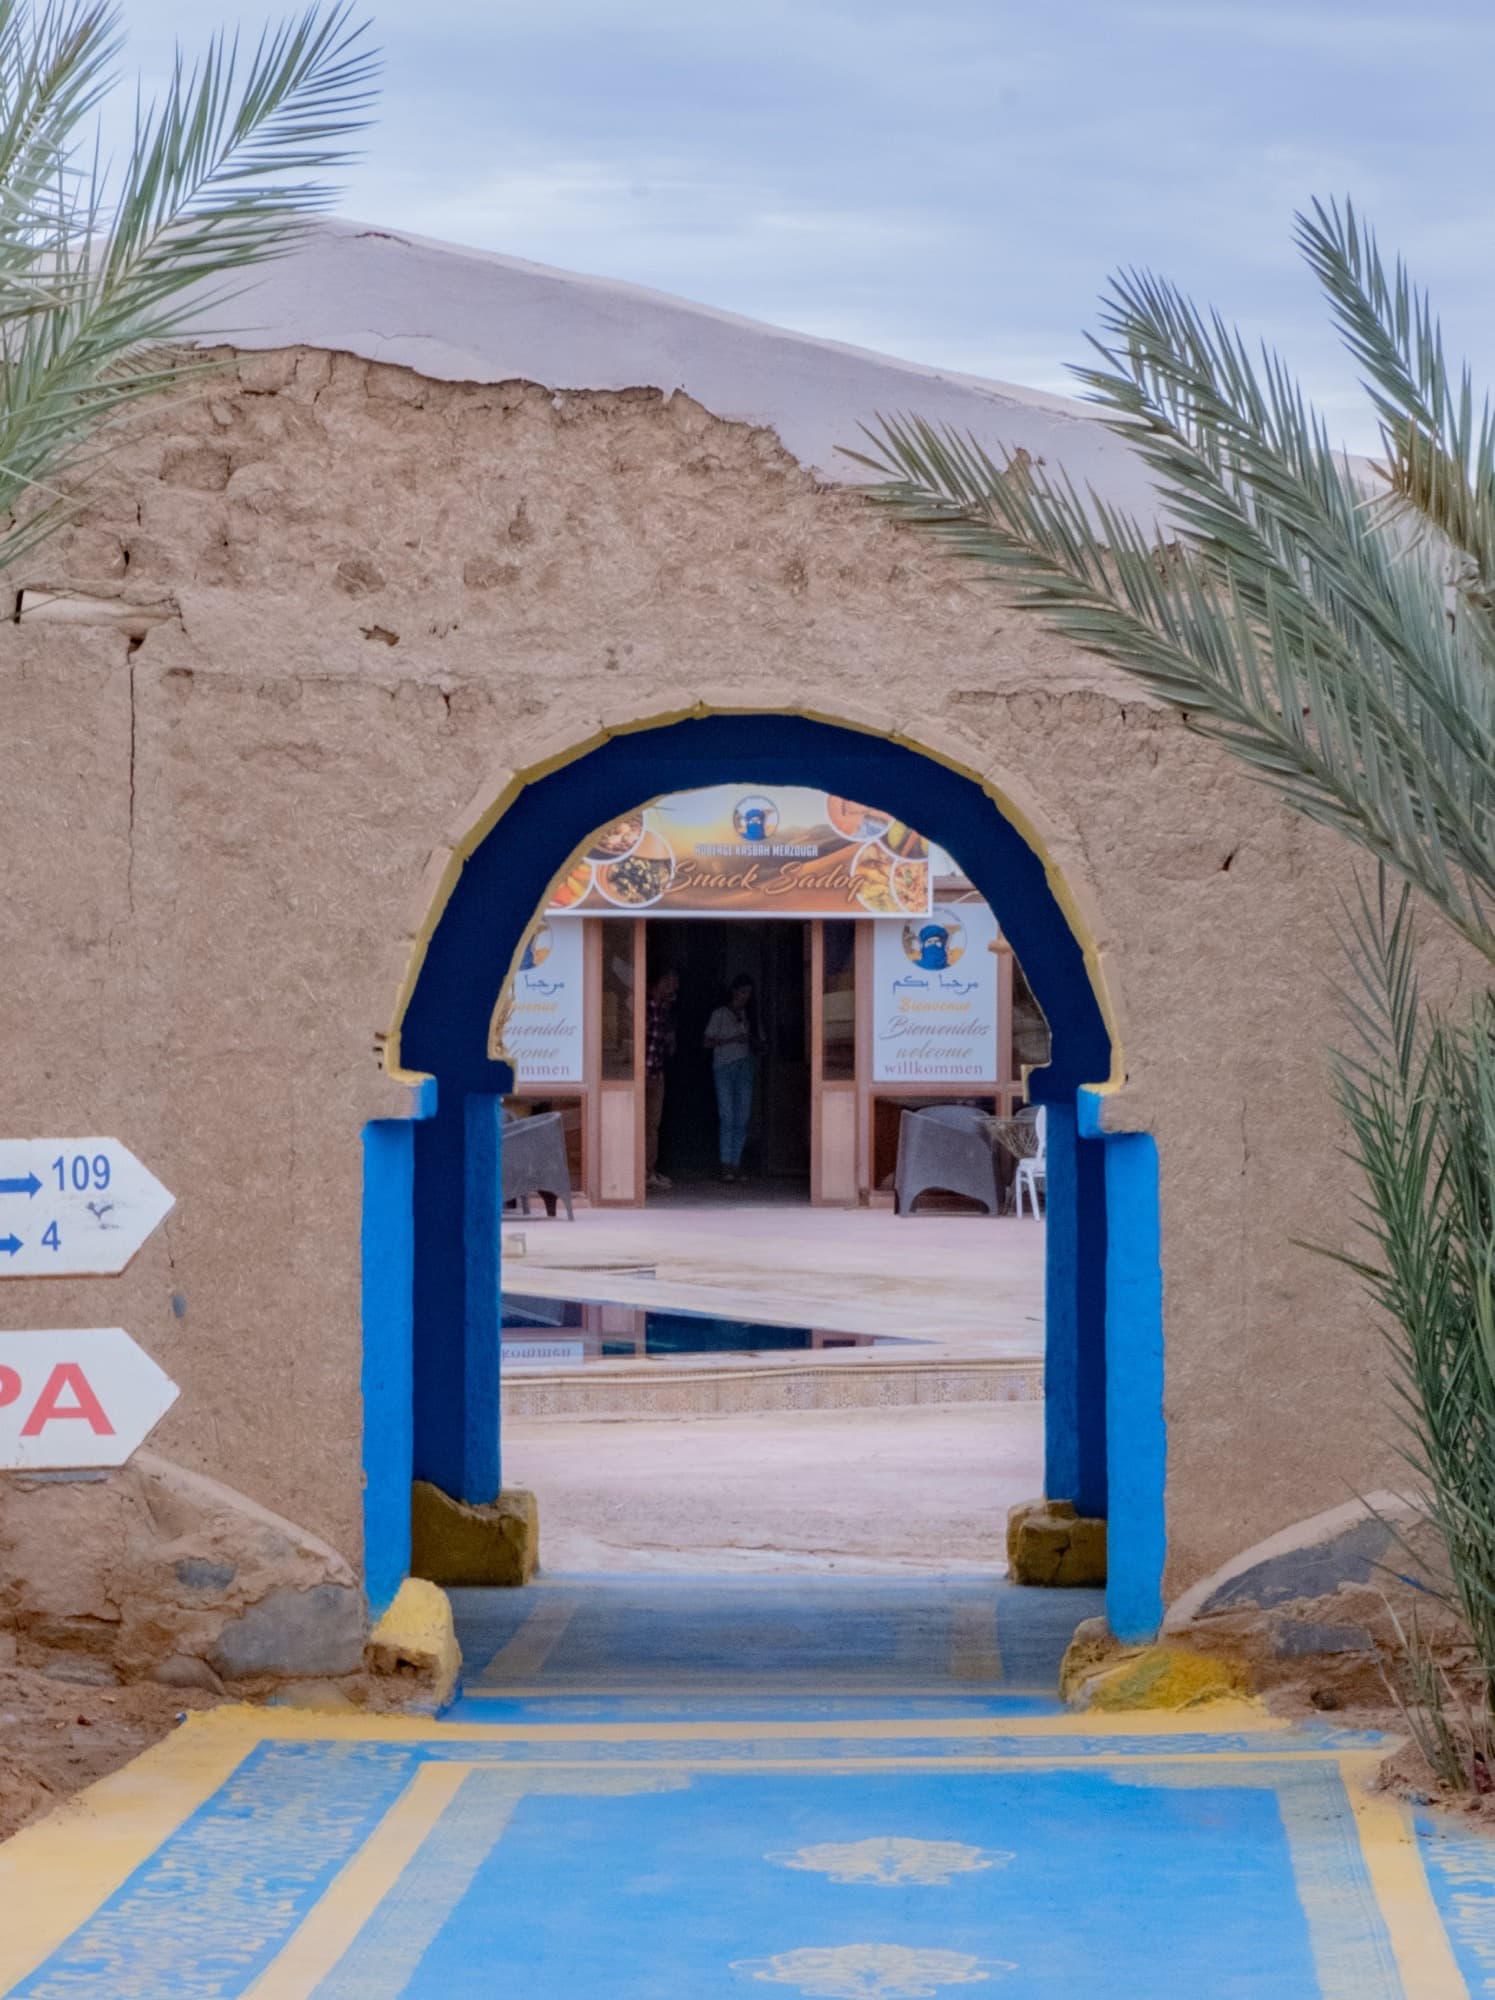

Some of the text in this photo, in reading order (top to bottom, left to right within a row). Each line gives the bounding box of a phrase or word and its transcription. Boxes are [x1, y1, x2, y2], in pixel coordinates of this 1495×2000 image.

[772, 844, 818, 857] MERZOUGA
[661, 861, 866, 902] Snack Sadoq
[892, 973, 979, 996] مرحبا بكم
[898, 997, 972, 1012] Bienvenue
[879, 1015, 991, 1040] Bienvenidos
[896, 1040, 974, 1059] welcome
[884, 1060, 983, 1075] willkommen
[52, 1154, 111, 1191] 109
[41, 1220, 62, 1252] 4
